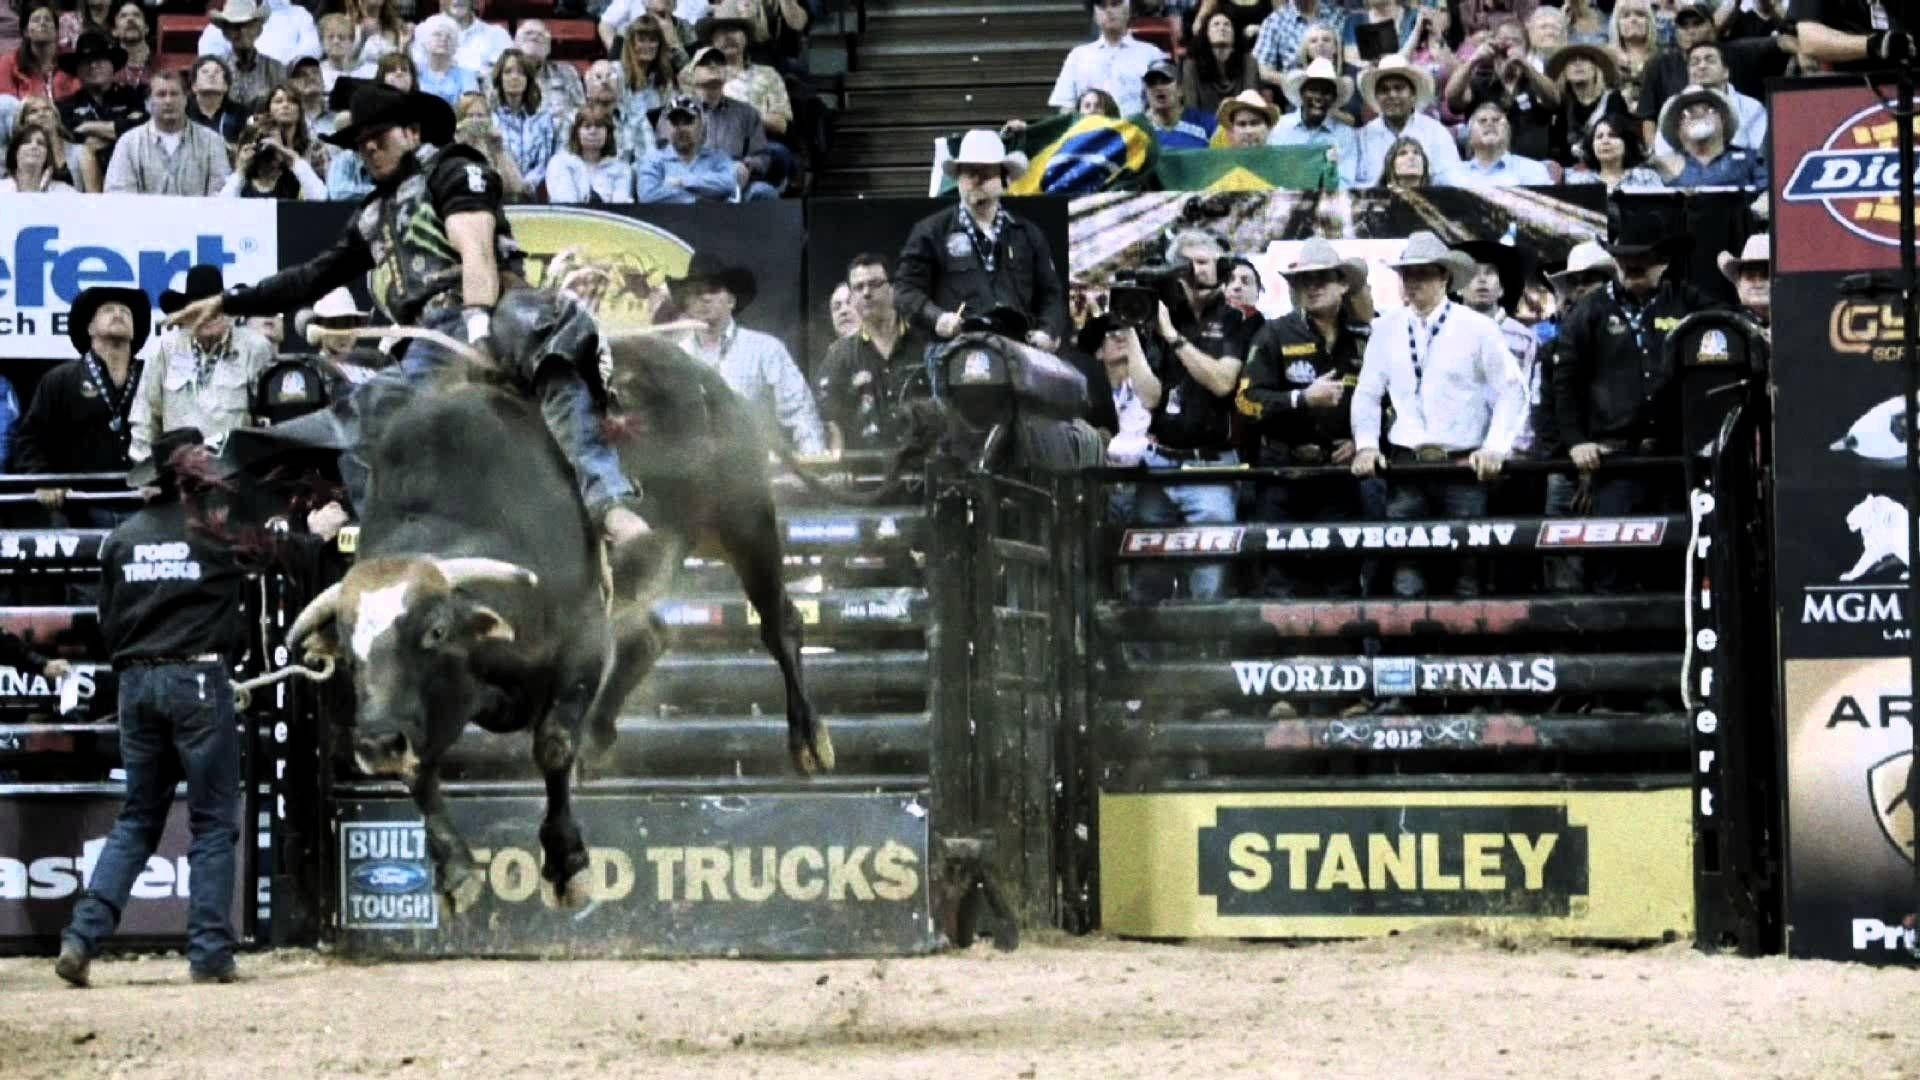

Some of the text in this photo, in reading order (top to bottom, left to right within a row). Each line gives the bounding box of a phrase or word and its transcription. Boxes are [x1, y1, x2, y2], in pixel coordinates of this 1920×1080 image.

[1129, 528, 1238, 552] PBR
[1266, 524, 1517, 550] LAS VEGAS, NV
[1547, 520, 1661, 544] PBR
[34, 534, 80, 558] NV
[133, 541, 190, 562] FORD
[121, 561, 201, 584] TRUCKS
[1801, 592, 1903, 624] MGM
[1231, 659, 1367, 695] WORLD
[1420, 658, 1557, 693] FINALS
[1372, 728, 1423, 750] 2012
[348, 829, 426, 859] BUILT
[471, 846, 636, 902] OD
[1228, 832, 1559, 892] STANLEY
[350, 894, 431, 919] TOUGH
